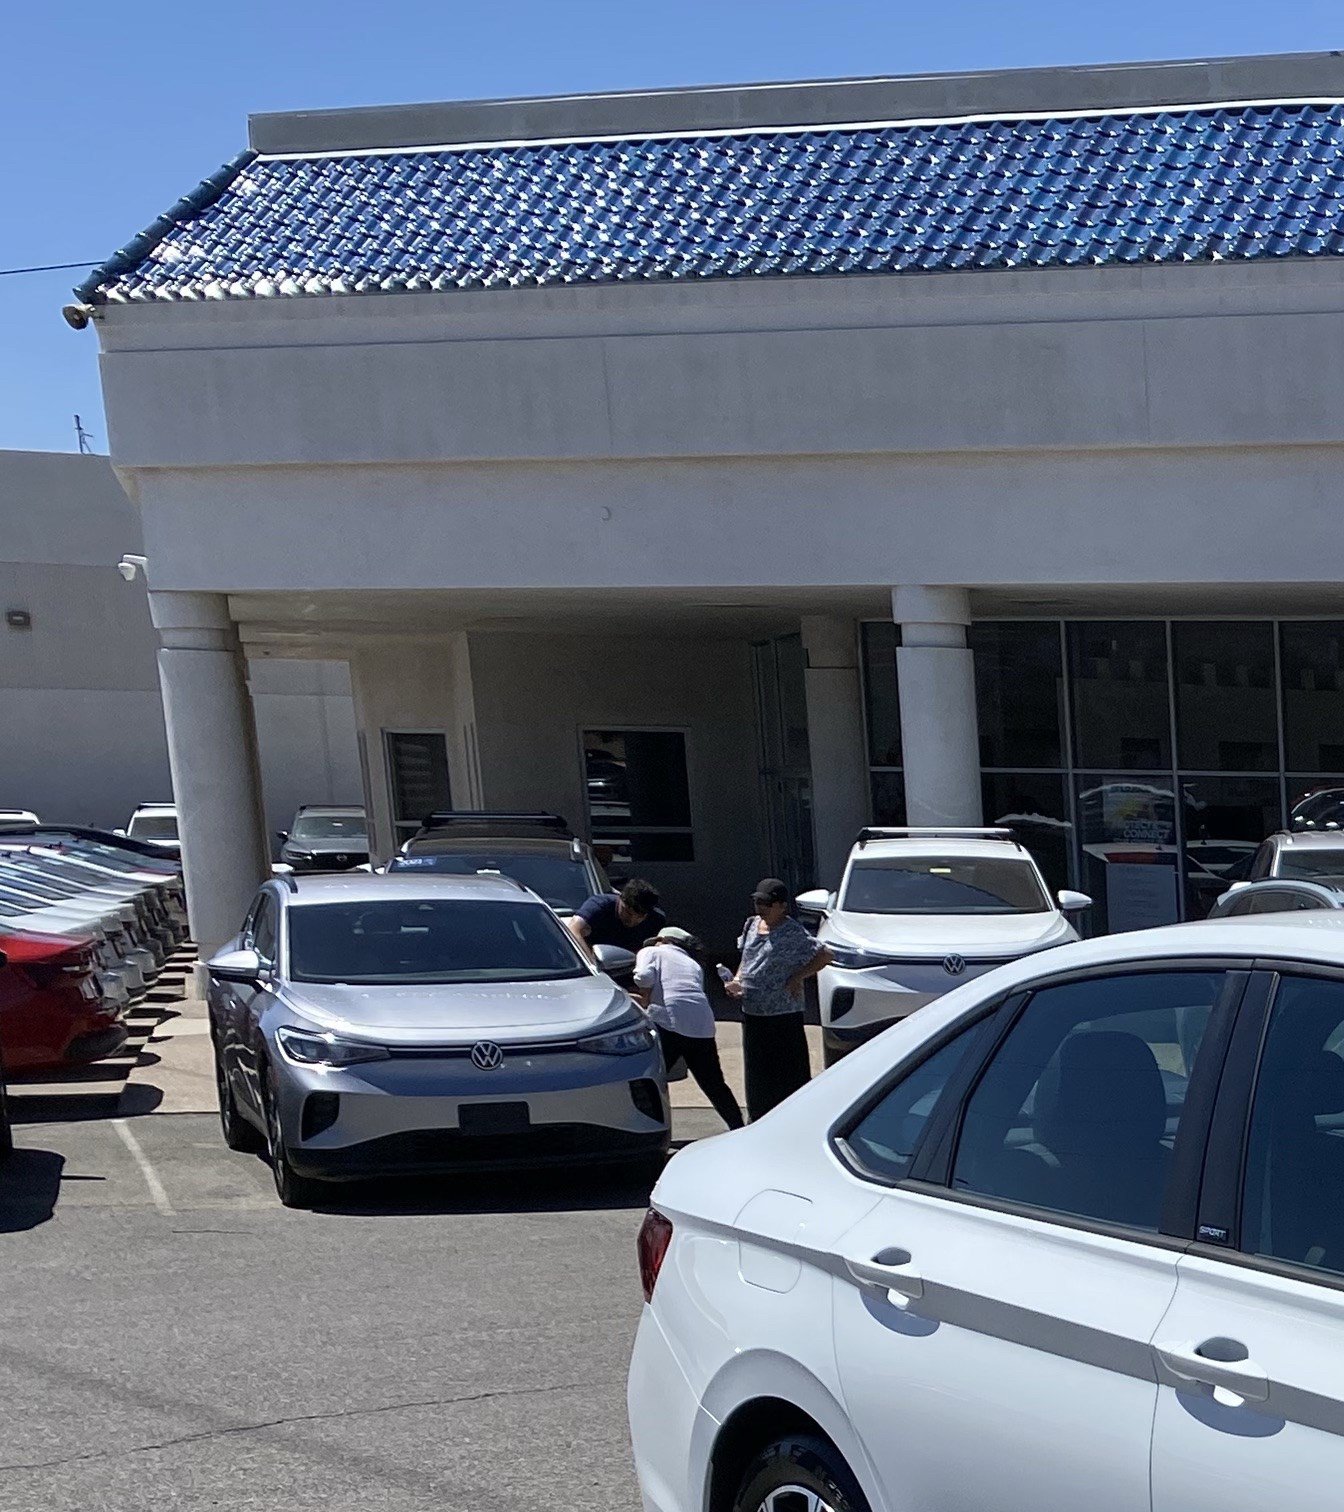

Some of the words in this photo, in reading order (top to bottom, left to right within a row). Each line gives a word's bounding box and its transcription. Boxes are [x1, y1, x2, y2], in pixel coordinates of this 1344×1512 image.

[943, 952, 967, 976] VW
[470, 1041, 503, 1072] VW
[1199, 1225, 1226, 1239] SPORT
